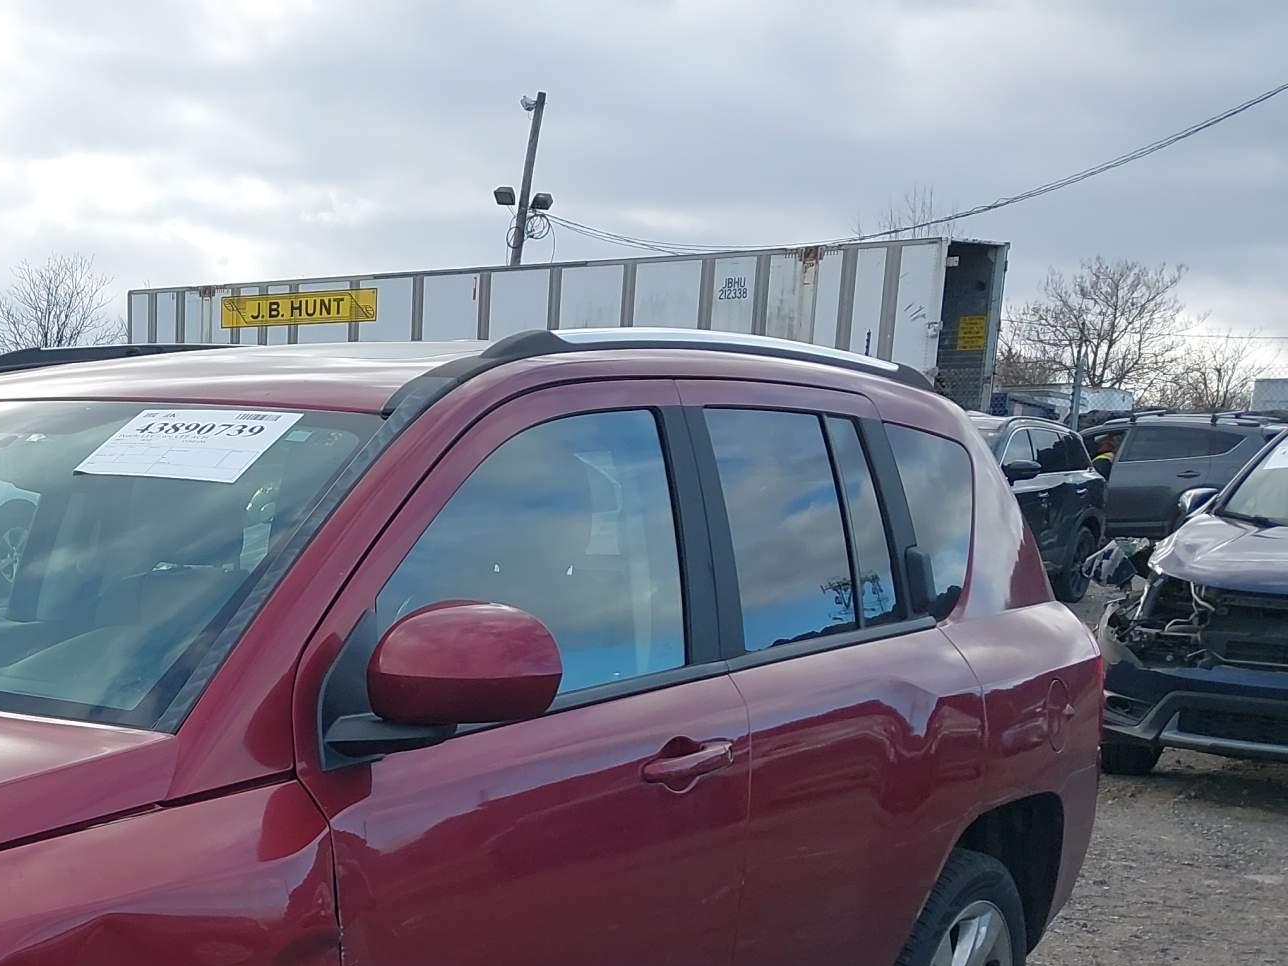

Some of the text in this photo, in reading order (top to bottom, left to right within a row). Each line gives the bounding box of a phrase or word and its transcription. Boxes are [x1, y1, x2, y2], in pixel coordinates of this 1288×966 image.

[722, 276, 746, 289] JBHU
[718, 288, 748, 300] 212338
[290, 297, 345, 318] HUNT
[135, 421, 265, 438] 43890739
